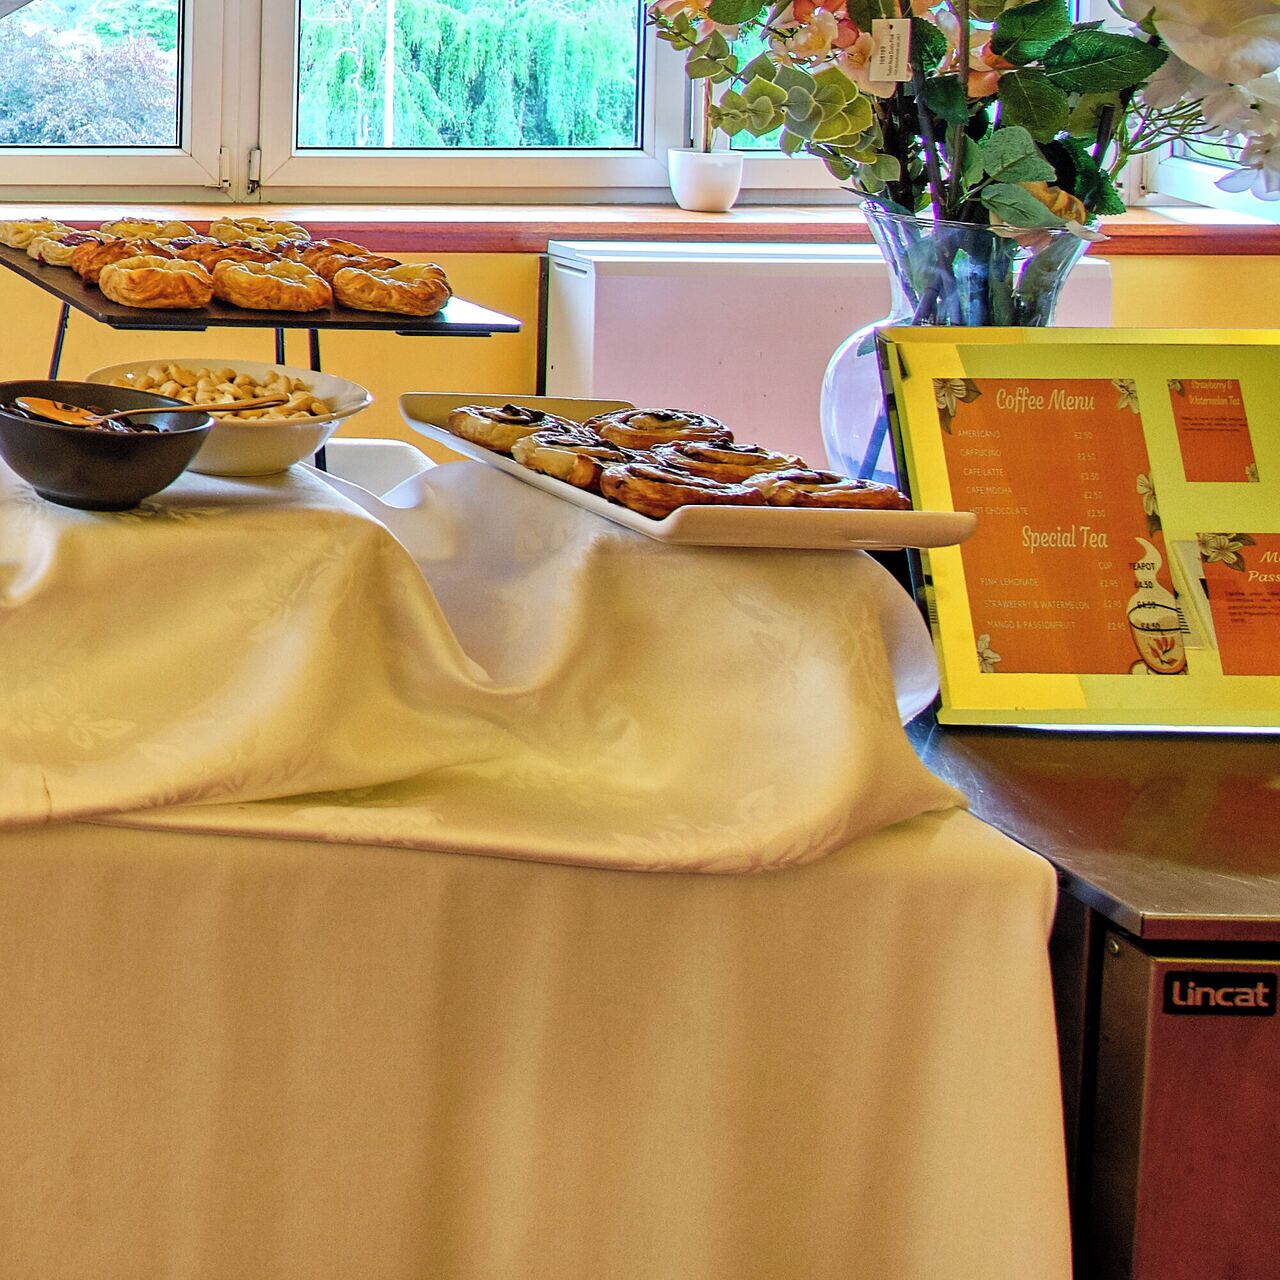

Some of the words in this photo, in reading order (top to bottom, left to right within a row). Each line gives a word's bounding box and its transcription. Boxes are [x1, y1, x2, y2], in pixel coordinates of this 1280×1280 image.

[996, 386, 1044, 413] Coffee
[1047, 389, 1096, 411] Menu
[957, 430, 1001, 439] AMERICANO
[982, 468, 1005, 477] LATTE
[984, 506, 1029, 515] CHOCOLATE
[1022, 524, 1076, 554] Special
[1079, 526, 1109, 549] Tea
[1260, 551, 1280, 563] M
[1128, 562, 1156, 571] TEAPOT
[983, 599, 1031, 609] STRAWBERRY
[1040, 600, 1091, 610] WATERMELON
[1171, 980, 1271, 1008] Lincat
